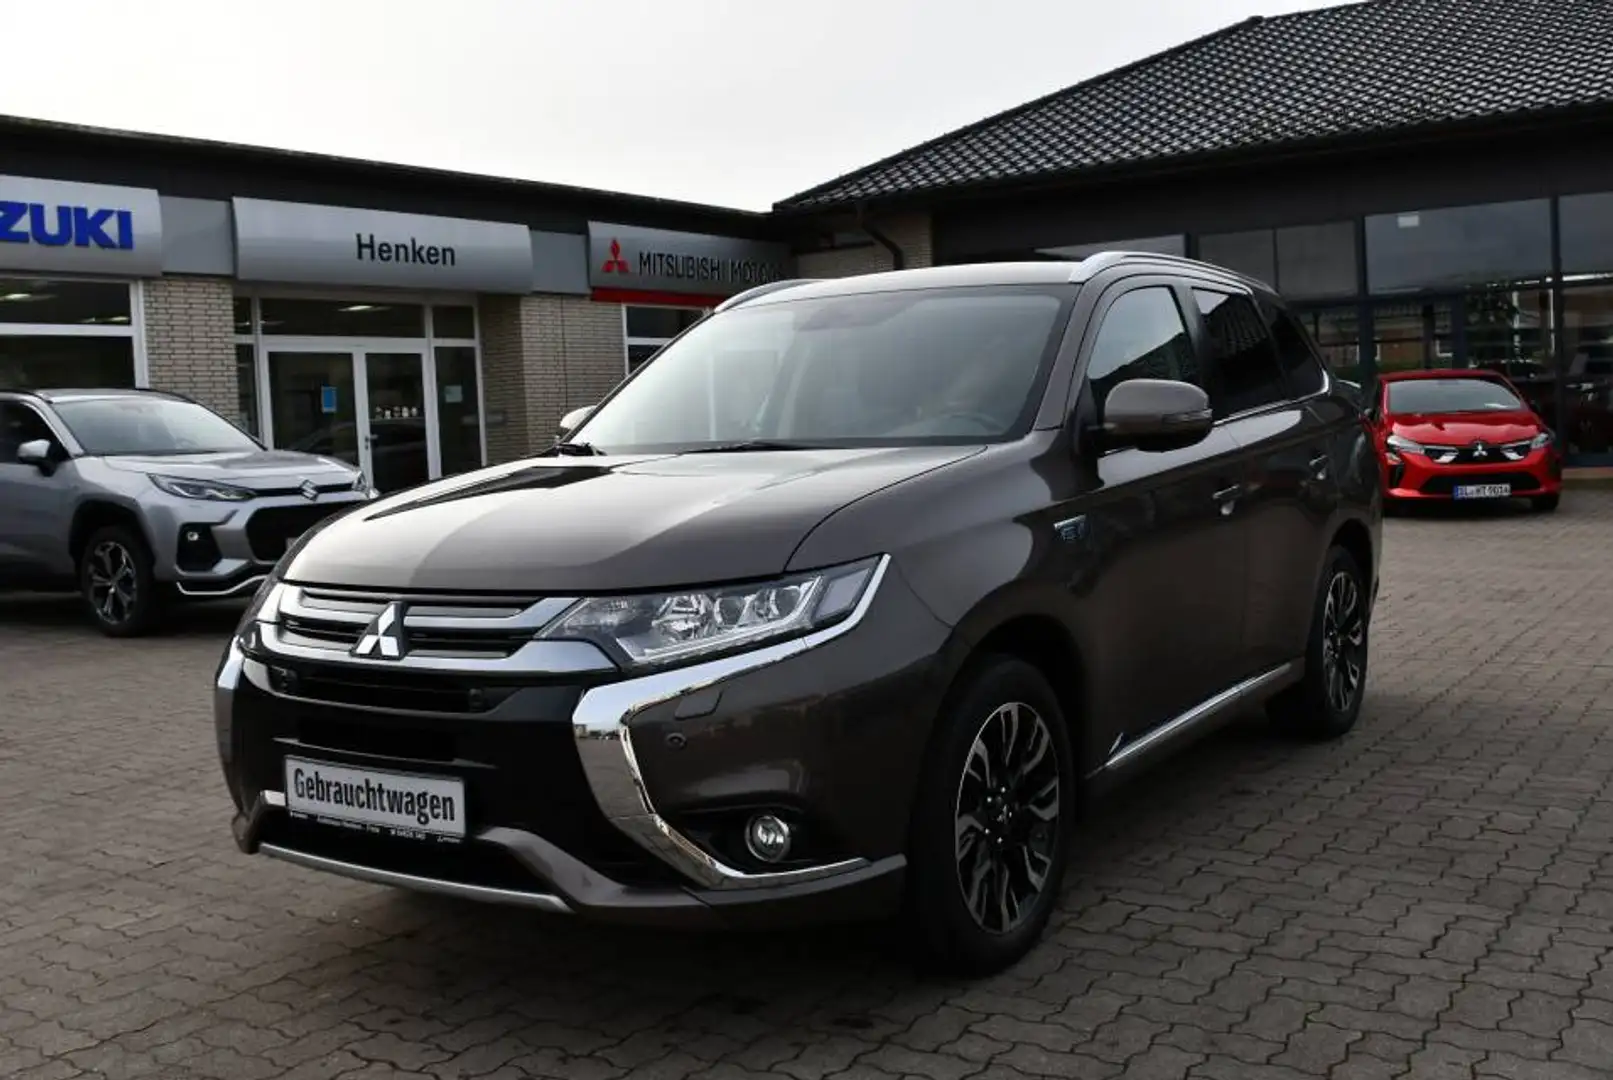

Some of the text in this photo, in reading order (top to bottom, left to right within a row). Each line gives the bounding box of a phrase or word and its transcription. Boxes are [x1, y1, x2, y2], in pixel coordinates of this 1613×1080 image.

[356, 233, 456, 266] Henken
[639, 251, 725, 281] MITSUBISHI
[294, 768, 455, 825] Gebrauchtwagen
